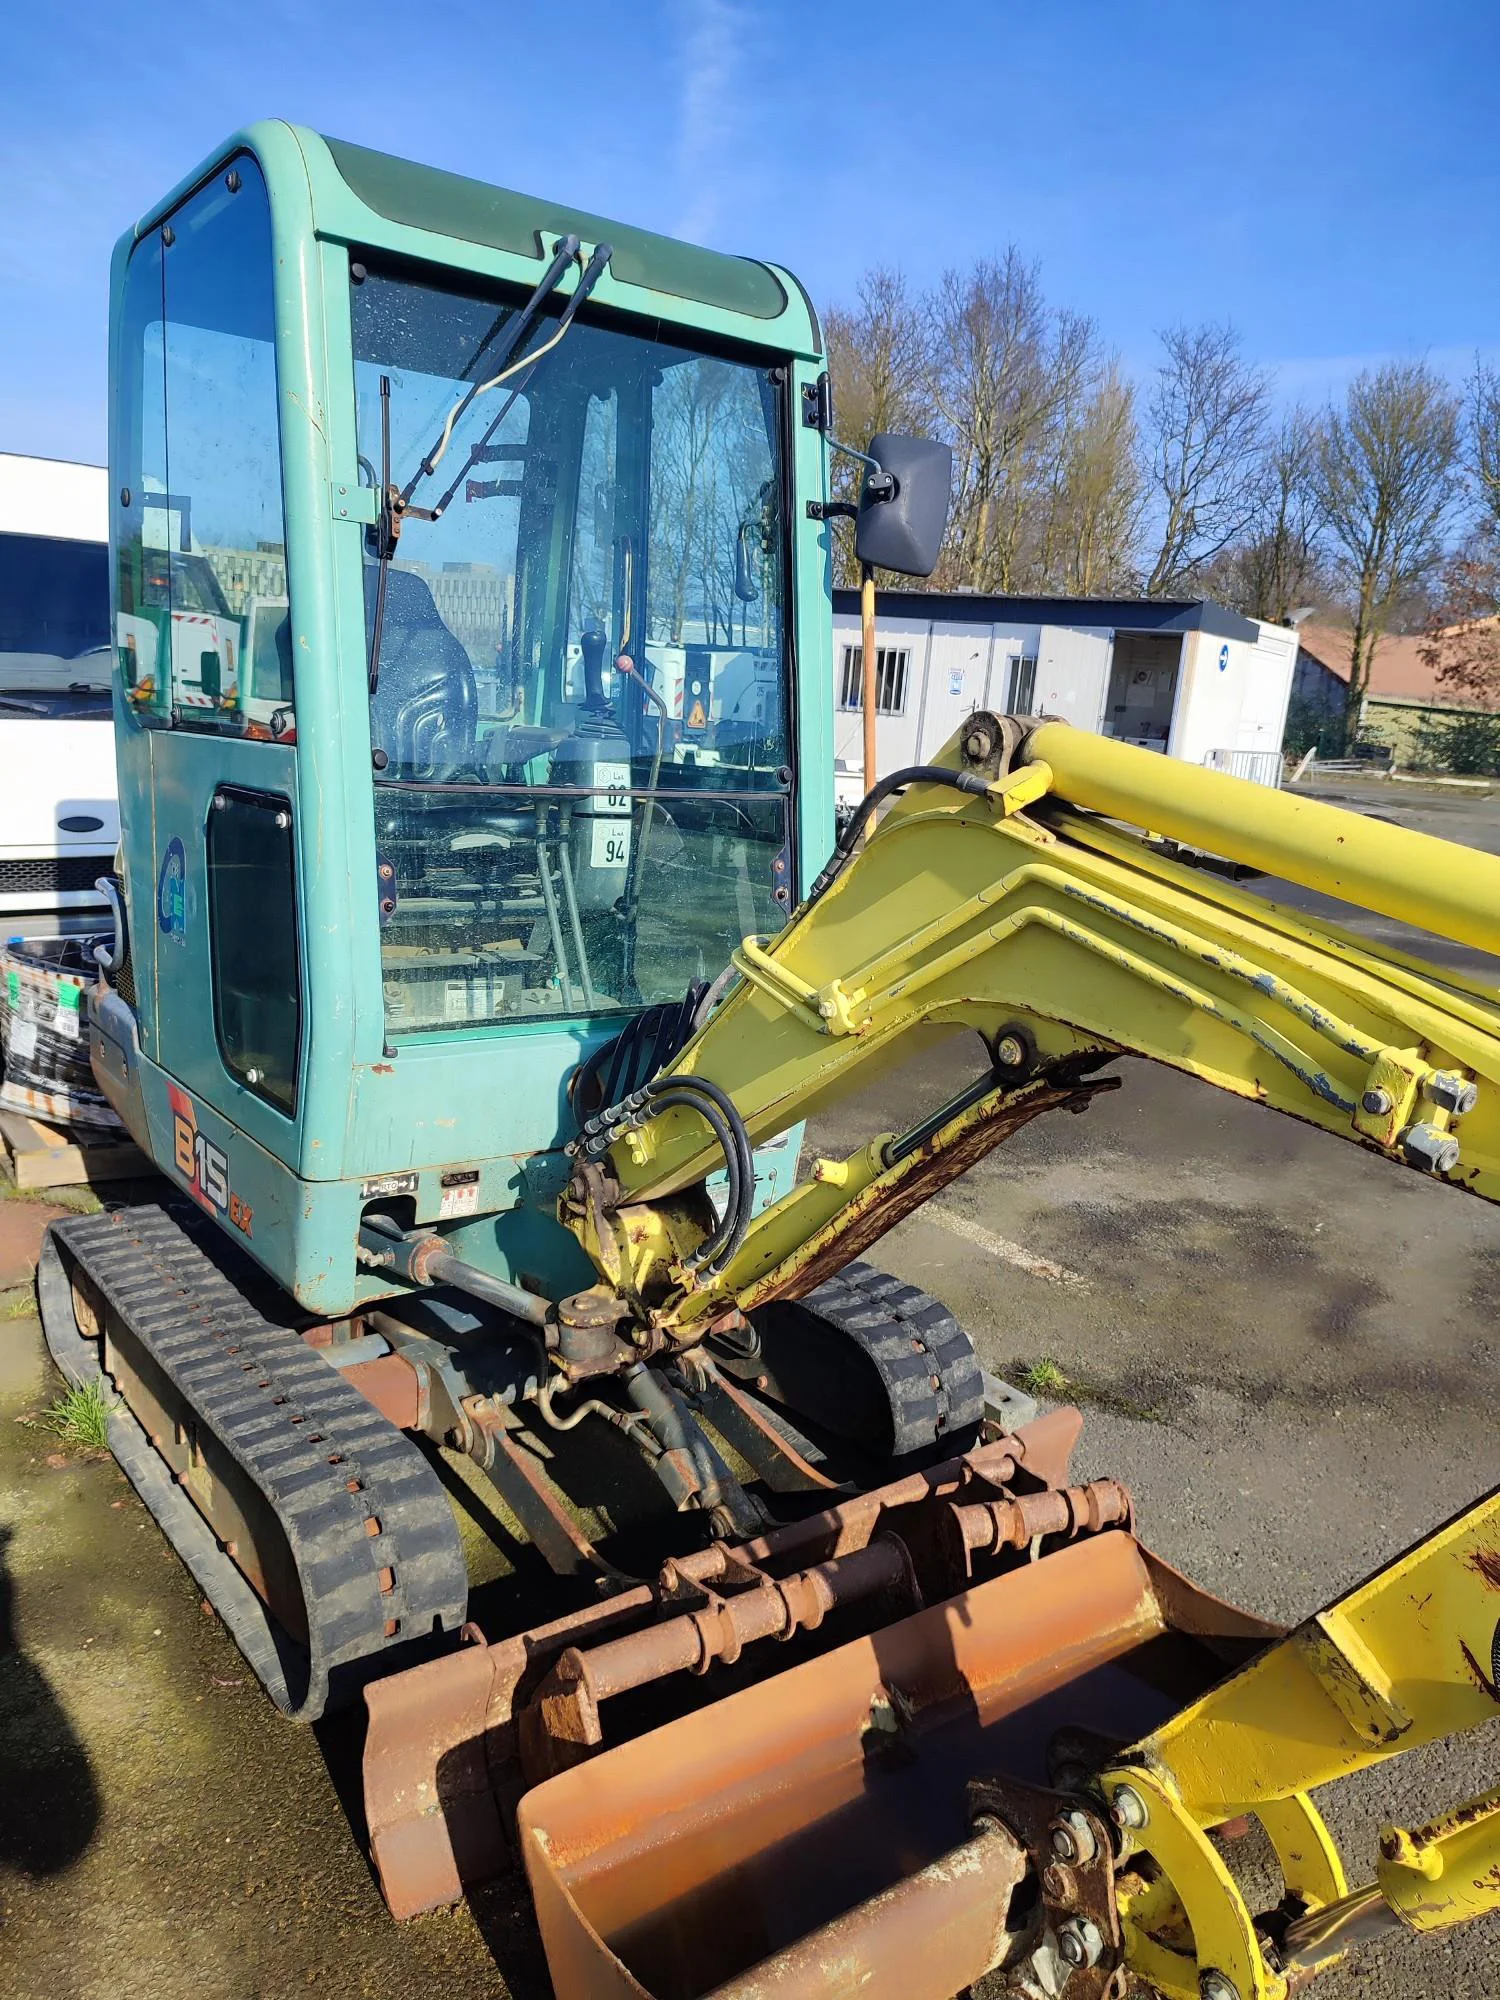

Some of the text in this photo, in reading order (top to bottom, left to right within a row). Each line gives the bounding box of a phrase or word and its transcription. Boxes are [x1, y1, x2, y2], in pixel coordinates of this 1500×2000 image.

[605, 840, 625, 863] 94
[174, 1111, 253, 1240] B15 EX
